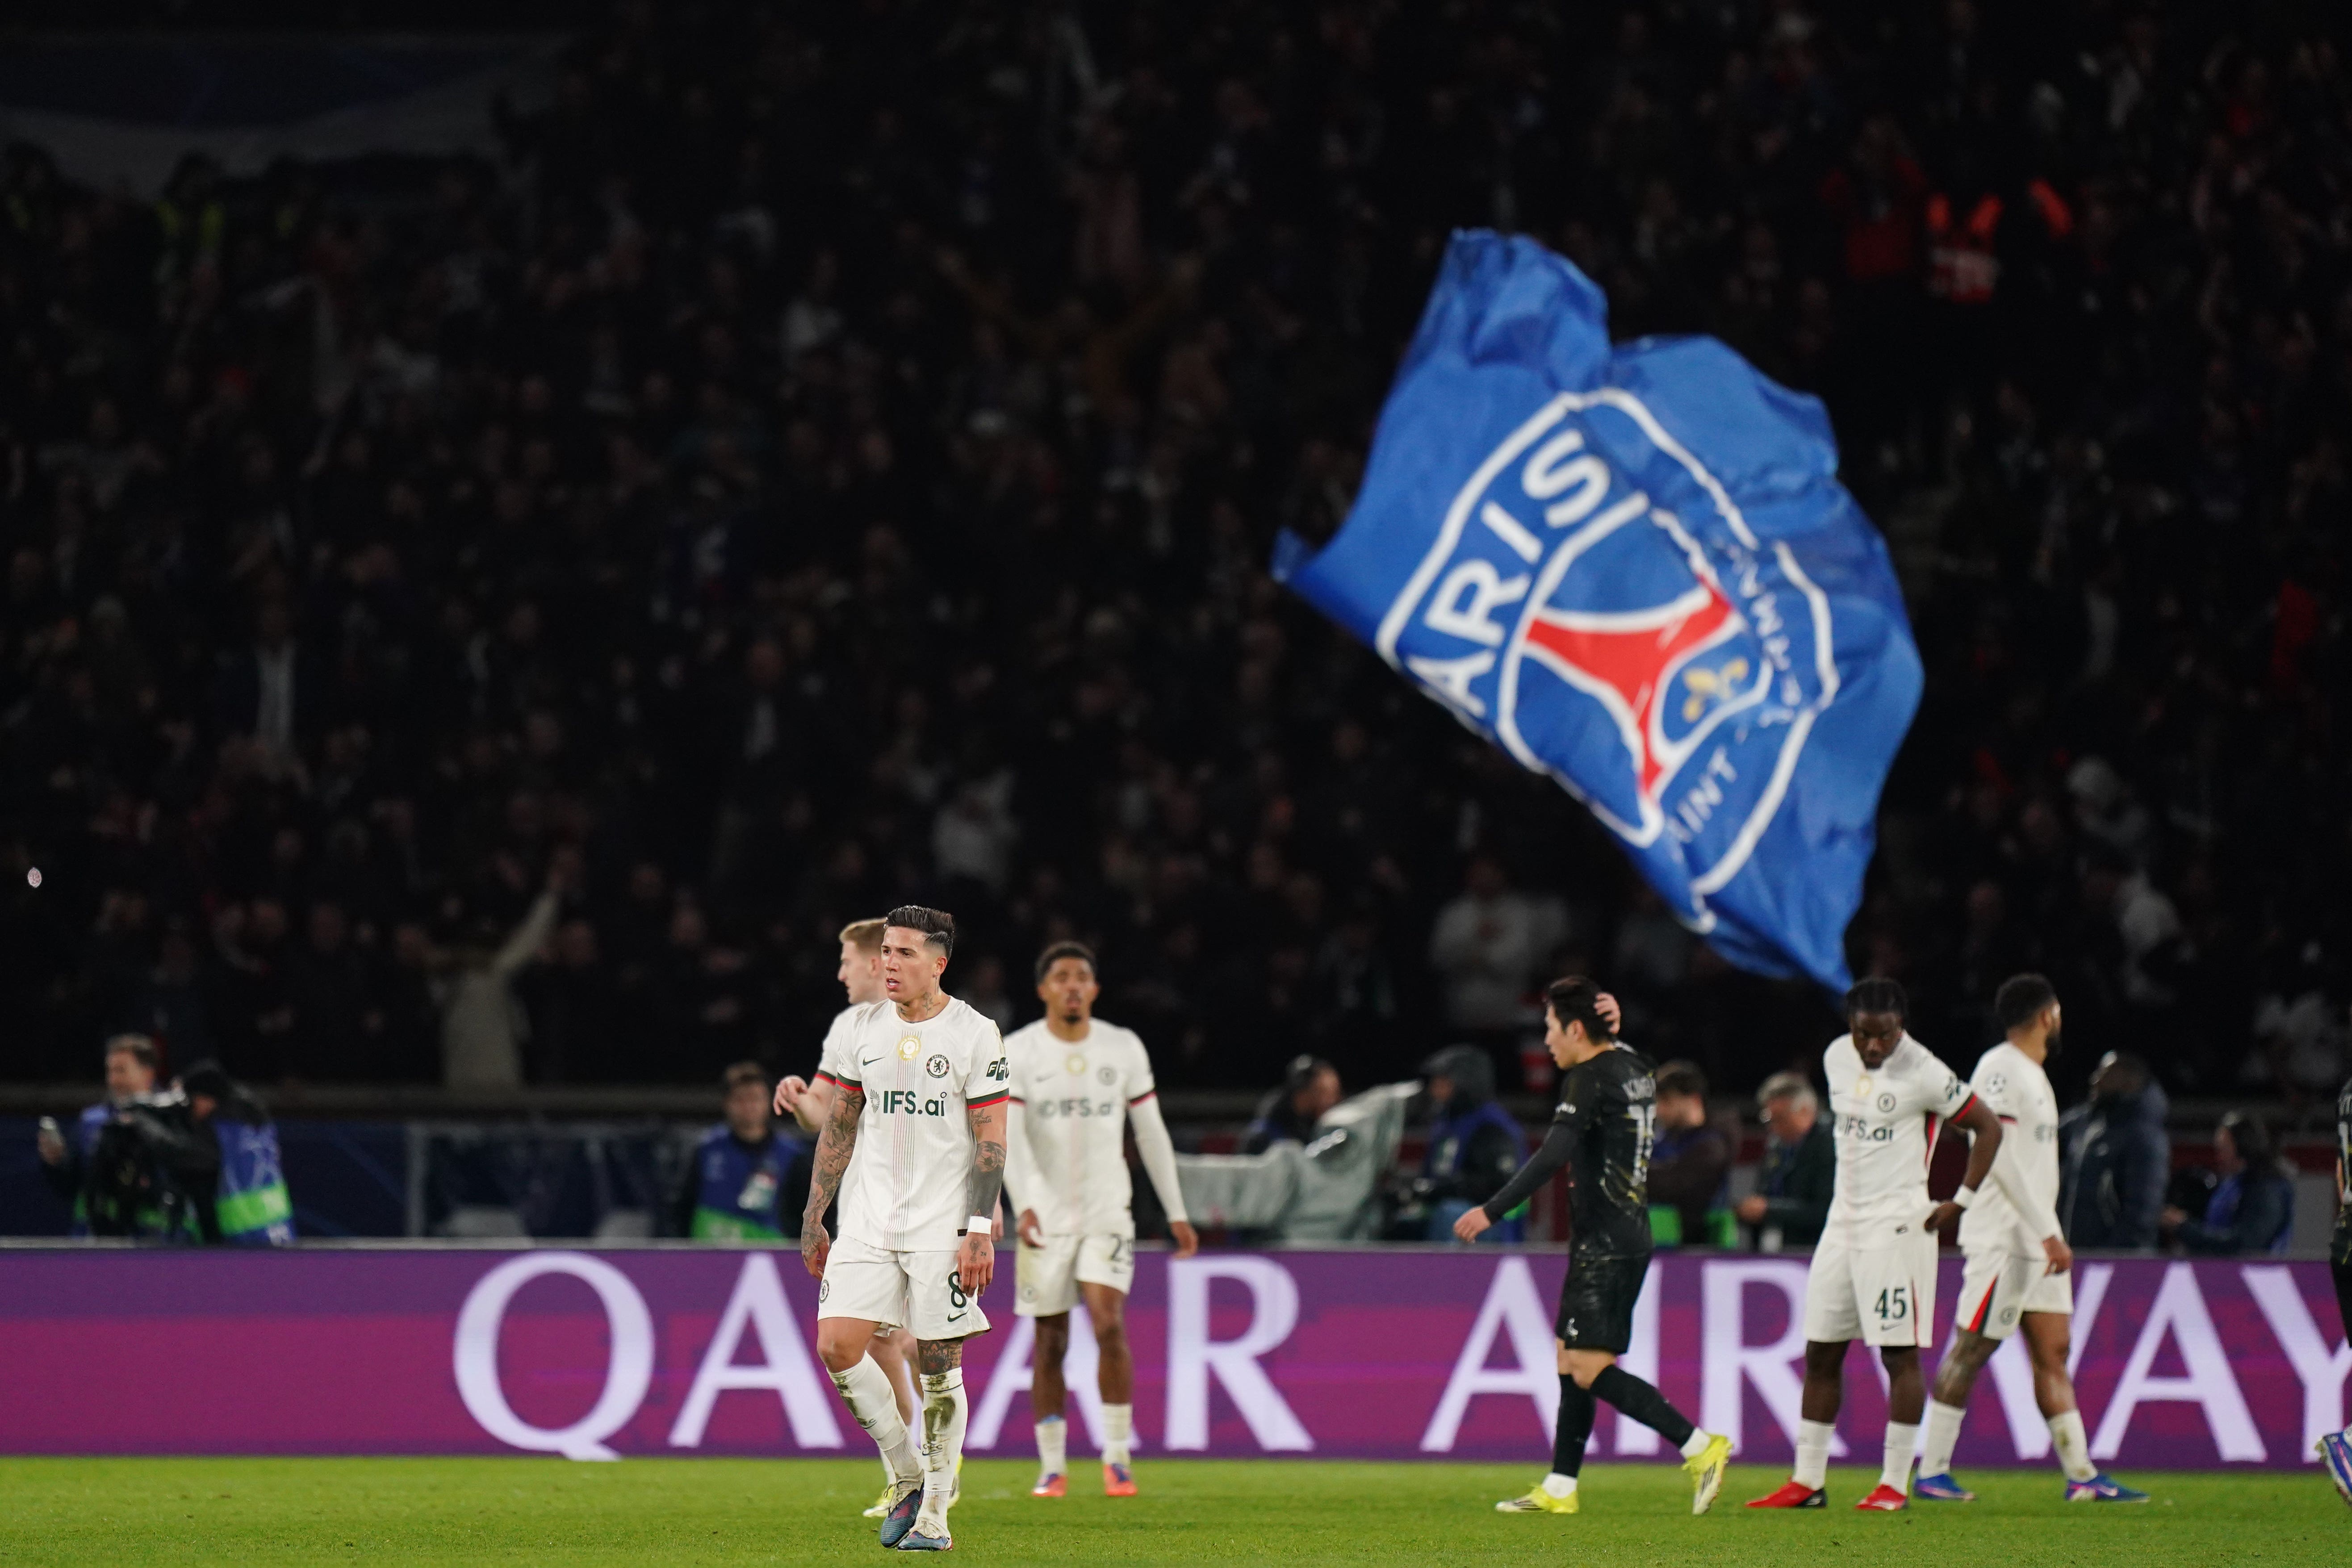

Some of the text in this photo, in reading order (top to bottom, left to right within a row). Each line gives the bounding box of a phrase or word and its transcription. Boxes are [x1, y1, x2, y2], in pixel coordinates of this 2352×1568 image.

[1406, 428, 1611, 718] ARIS
[883, 1091, 947, 1116] IFS.ai
[948, 1271, 967, 1309] 8
[1874, 1288, 1907, 1319] 45
[452, 1251, 1338, 1461] QAAR
